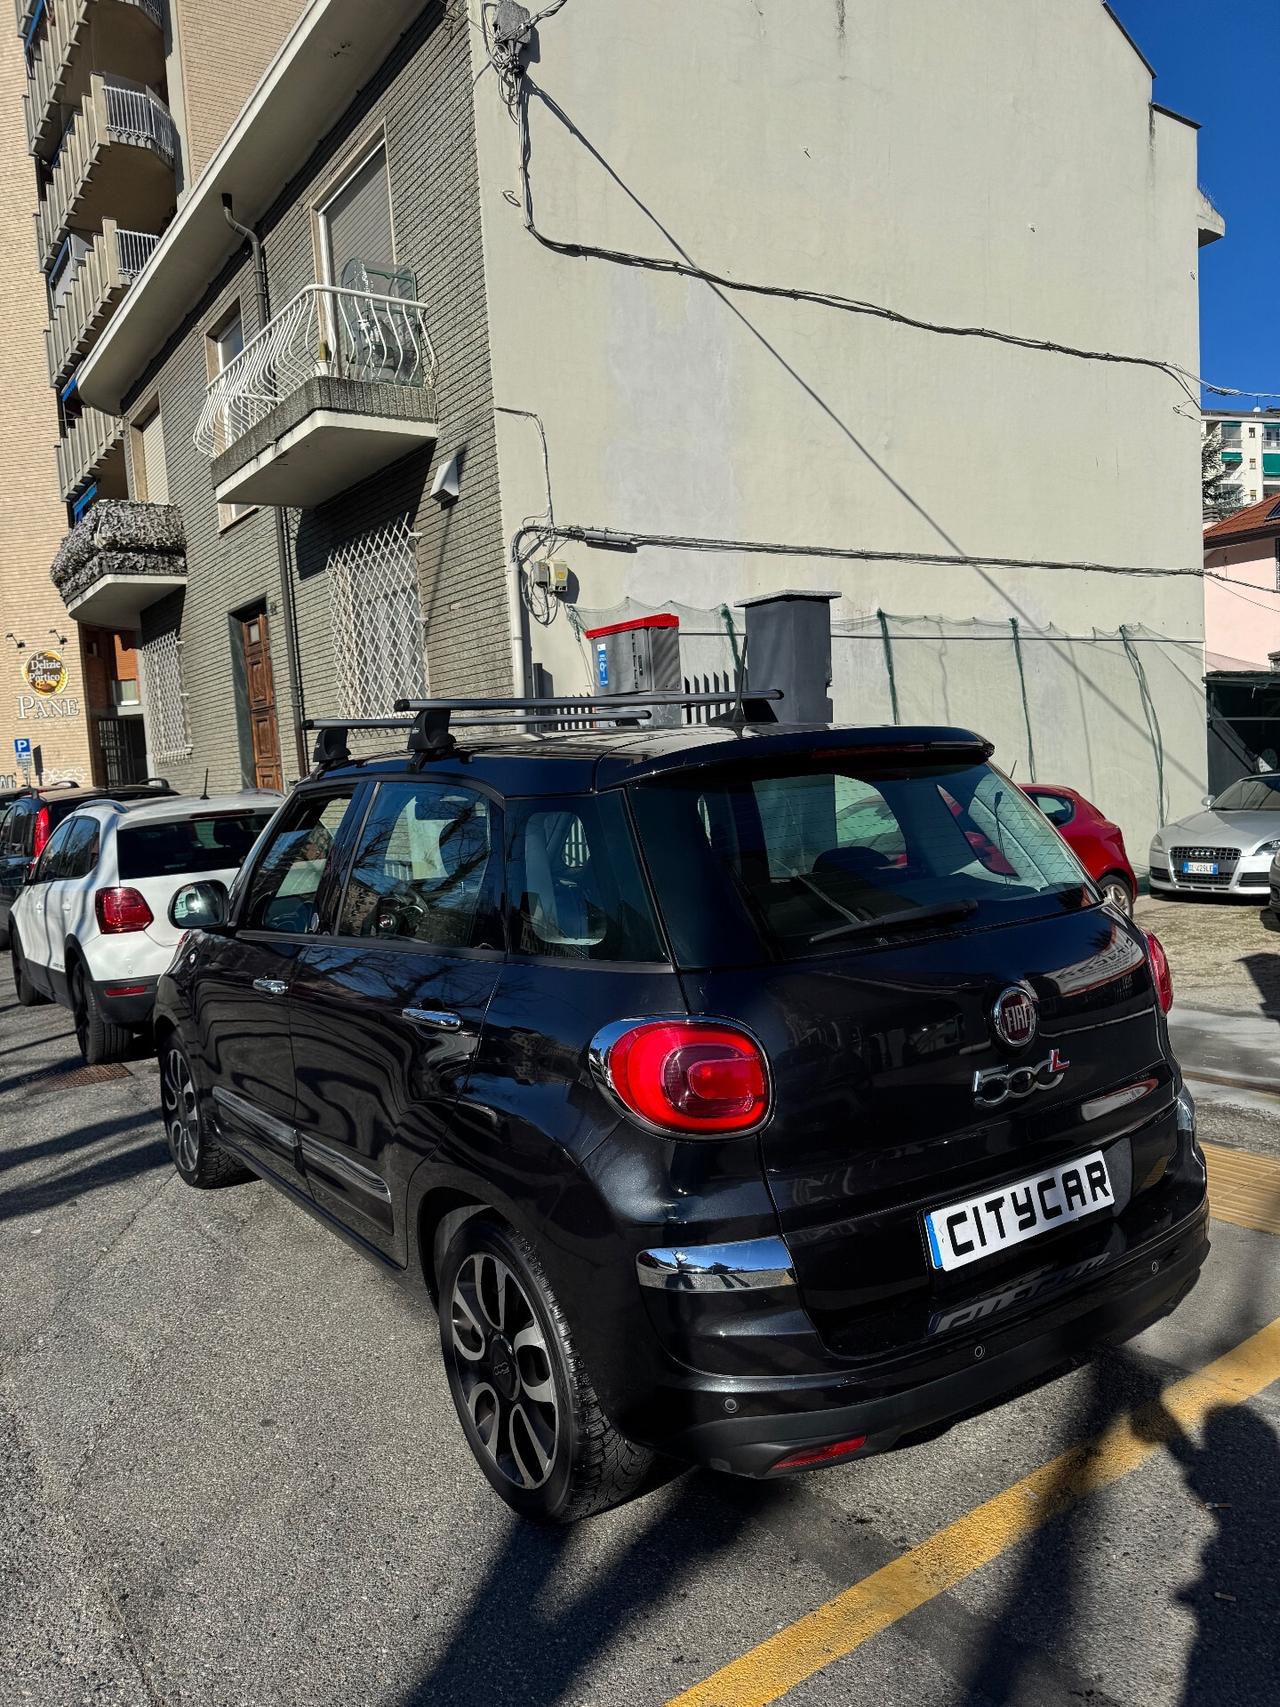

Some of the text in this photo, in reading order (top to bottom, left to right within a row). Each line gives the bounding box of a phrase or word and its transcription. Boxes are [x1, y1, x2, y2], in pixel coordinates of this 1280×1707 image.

[31, 660, 61, 670] Delizie
[29, 672, 60, 682] Portico
[16, 695, 80, 719] PANE
[17, 740, 28, 752] P
[1005, 1003, 1031, 1032] FIAT
[946, 1160, 1111, 1257] CITYCAR
